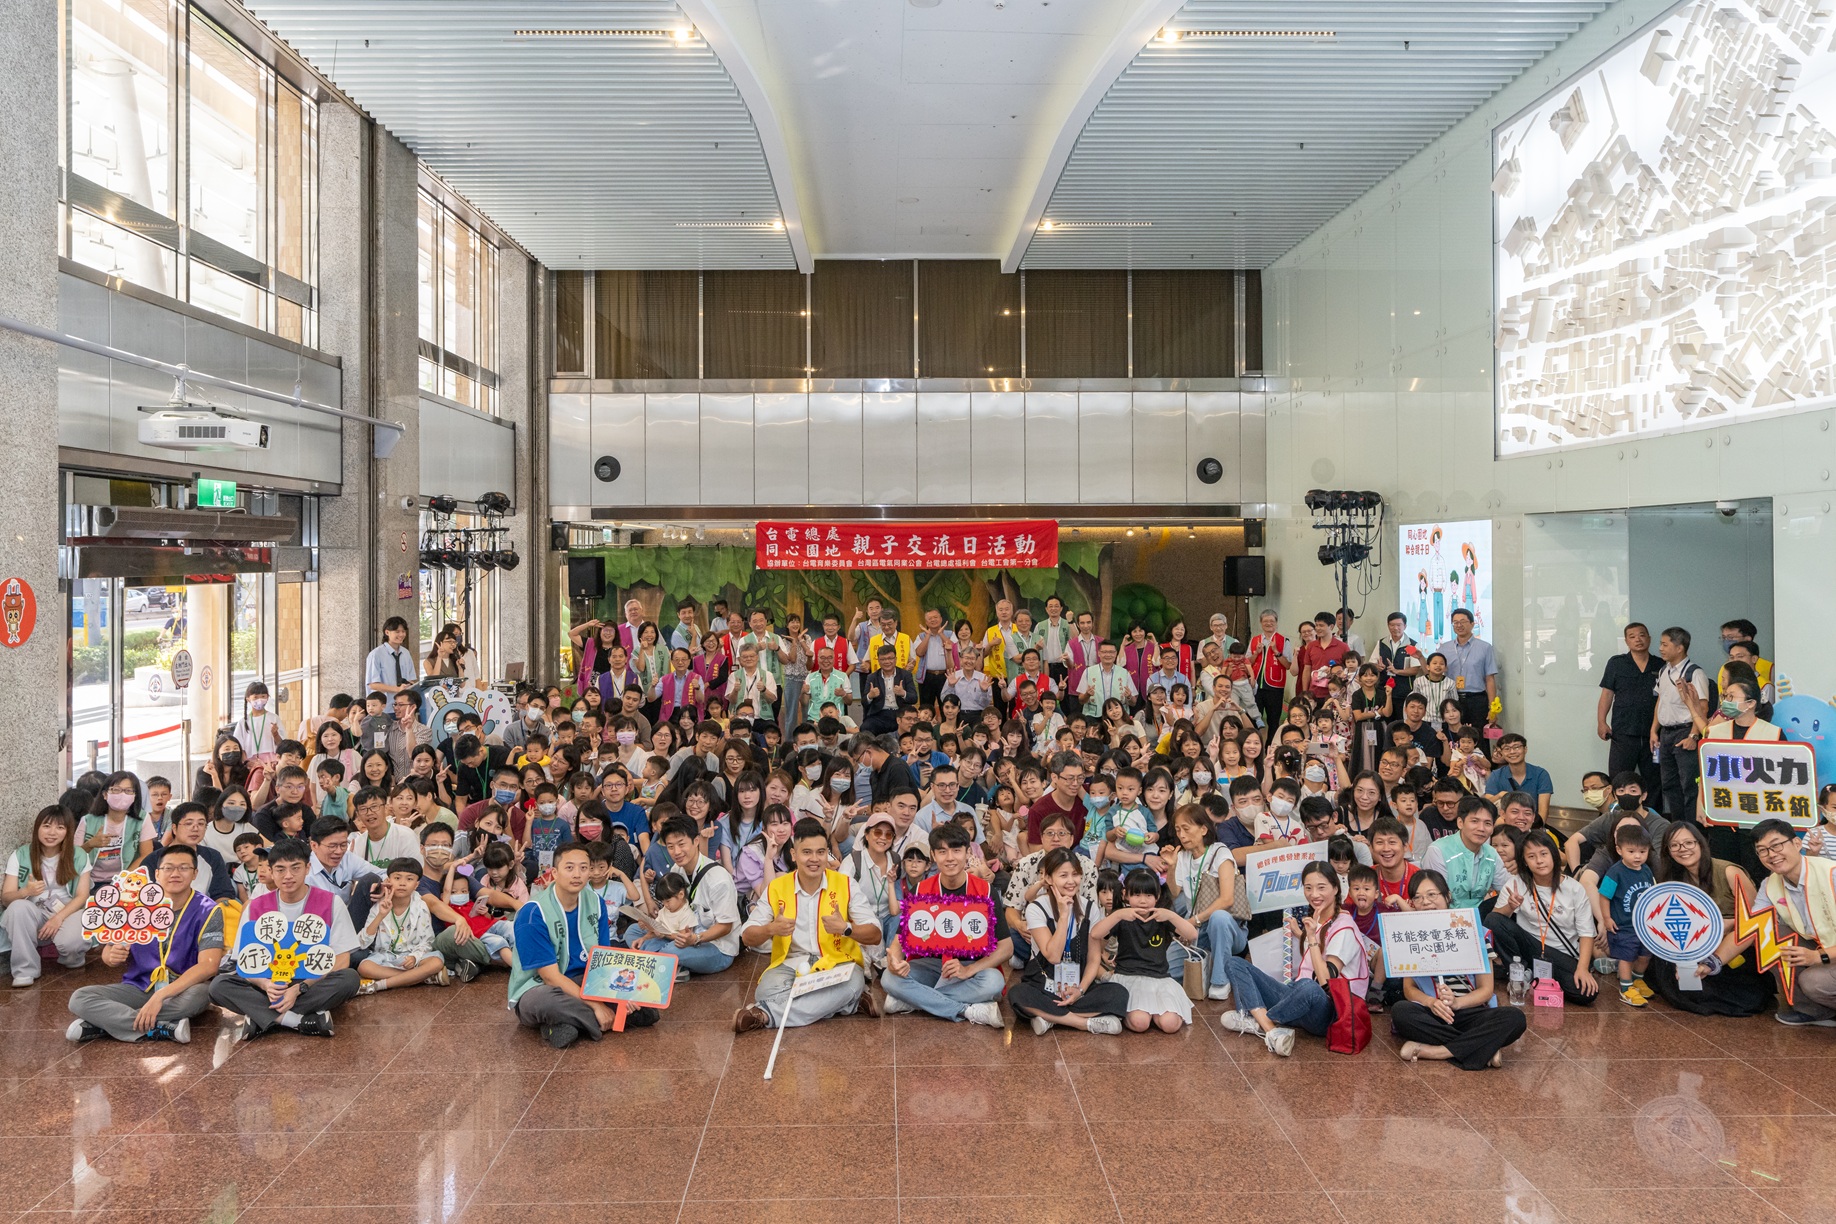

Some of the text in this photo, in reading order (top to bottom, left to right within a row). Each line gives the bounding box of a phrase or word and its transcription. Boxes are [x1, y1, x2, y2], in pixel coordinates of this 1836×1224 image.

[766, 526, 841, 541] 台電總處
[766, 543, 840, 557] 同心園地
[851, 533, 1036, 556] 親子交流日活動
[1706, 754, 1809, 786] 水火力
[1712, 786, 1813, 818] 發電系統
[86, 908, 171, 926] 資源系統
[914, 917, 982, 934] 配售電
[101, 929, 149, 941] 2025
[1392, 927, 1469, 943] 核能發電系統
[1409, 941, 1459, 954] 同心園地
[590, 950, 657, 978] 數位發展系統
